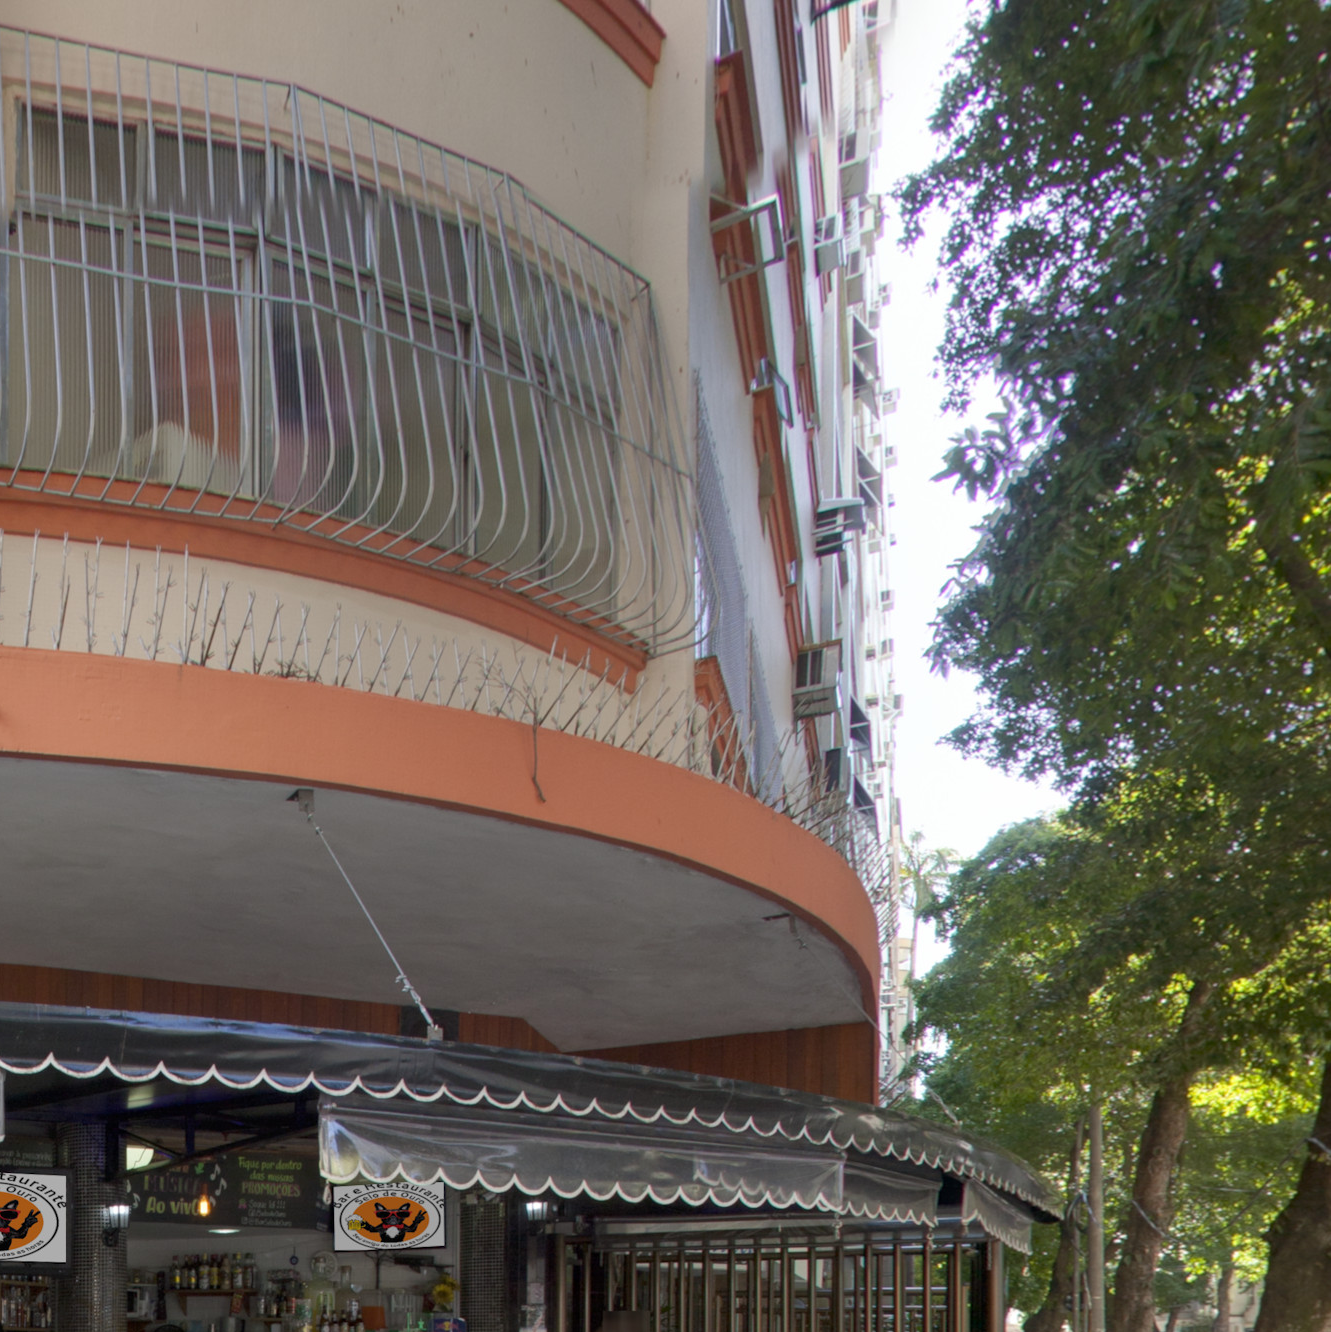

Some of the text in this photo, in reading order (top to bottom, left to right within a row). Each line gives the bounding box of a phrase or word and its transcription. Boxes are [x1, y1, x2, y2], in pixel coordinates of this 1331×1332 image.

[275, 1160, 303, 1171] dentro
[6, 1185, 38, 1203] Ouro
[353, 1187, 362, 1195] e
[364, 1182, 445, 1209] Restaurante
[354, 1192, 379, 1205] Selo
[401, 1192, 425, 1205] Ouro
[145, 1196, 166, 1214] Ao
[16, 1248, 26, 1256] as
[25, 1239, 45, 1253] horas
